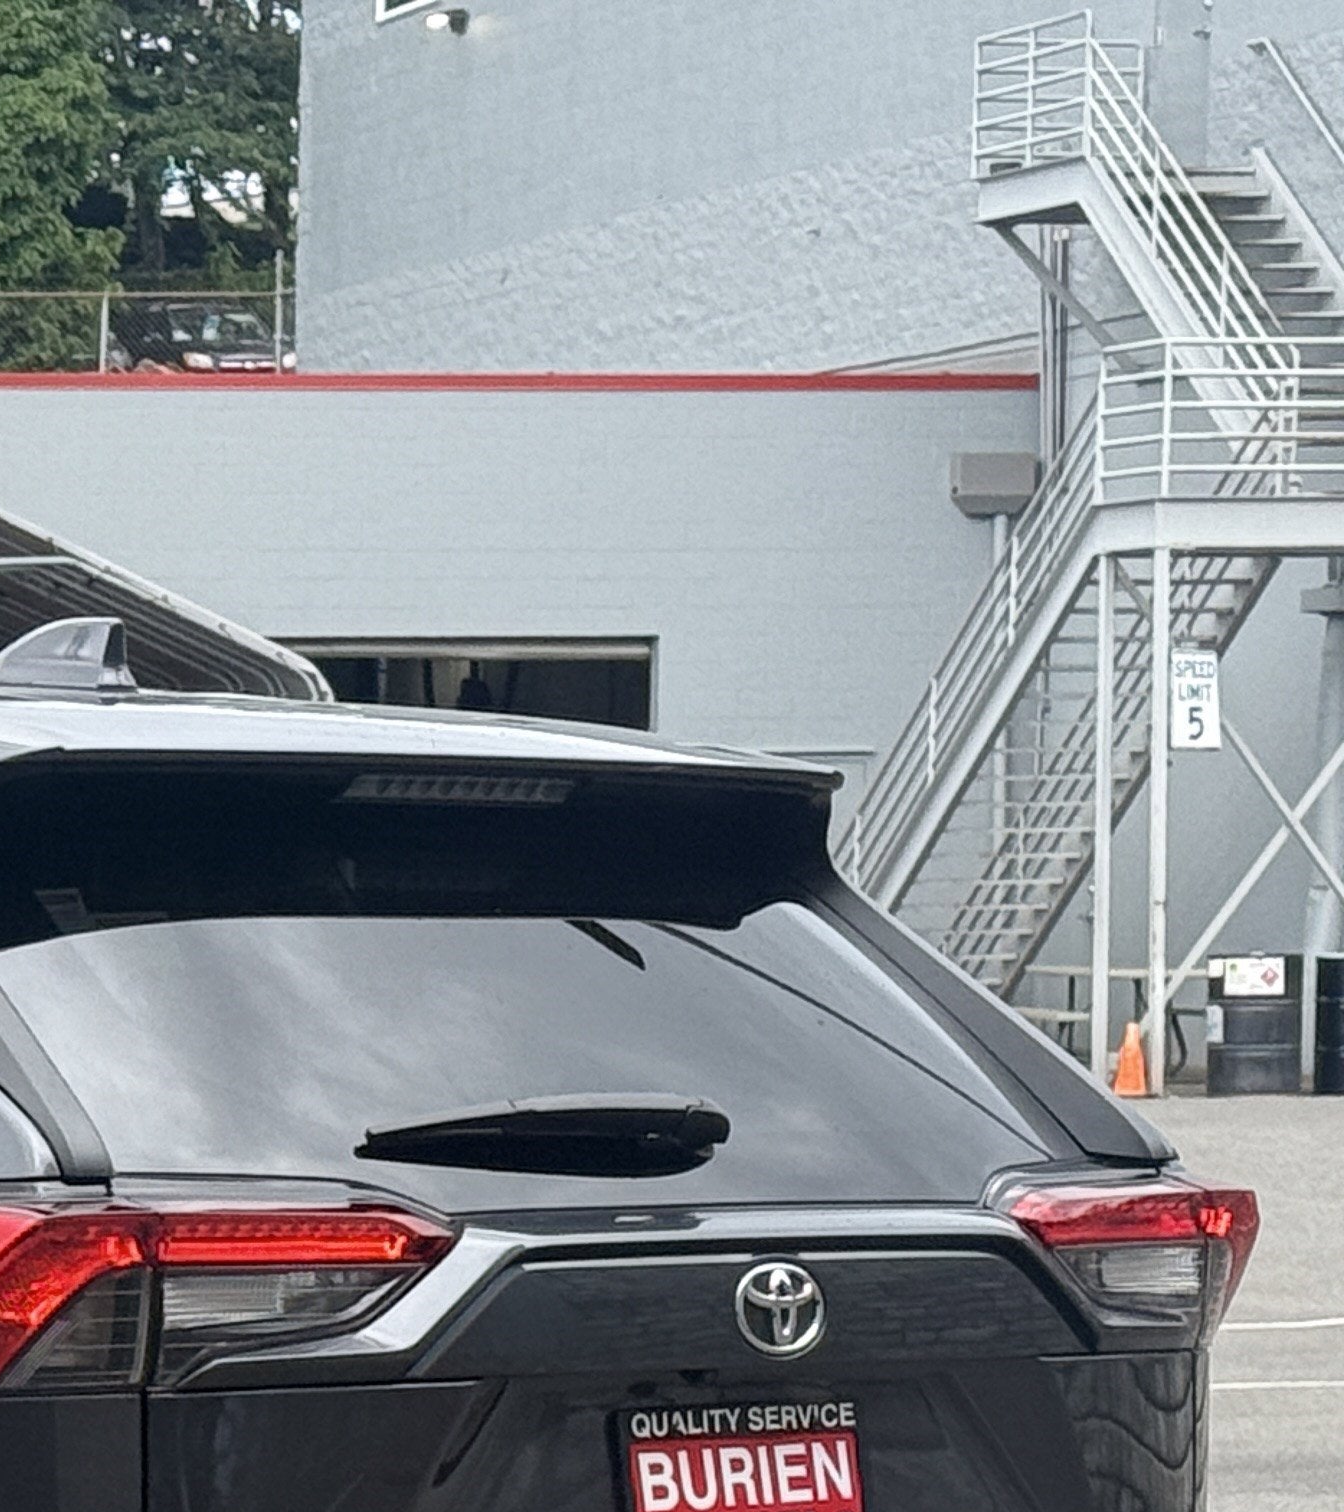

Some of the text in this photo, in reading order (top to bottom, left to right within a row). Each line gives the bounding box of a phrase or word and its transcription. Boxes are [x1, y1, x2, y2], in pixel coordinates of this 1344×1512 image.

[1174, 660, 1215, 678] SPEED
[1178, 683, 1212, 701] LIMIT
[1188, 706, 1204, 741] 5
[630, 1402, 857, 1438] QUALITY SERVICE
[637, 1439, 854, 1512] BURIEN
